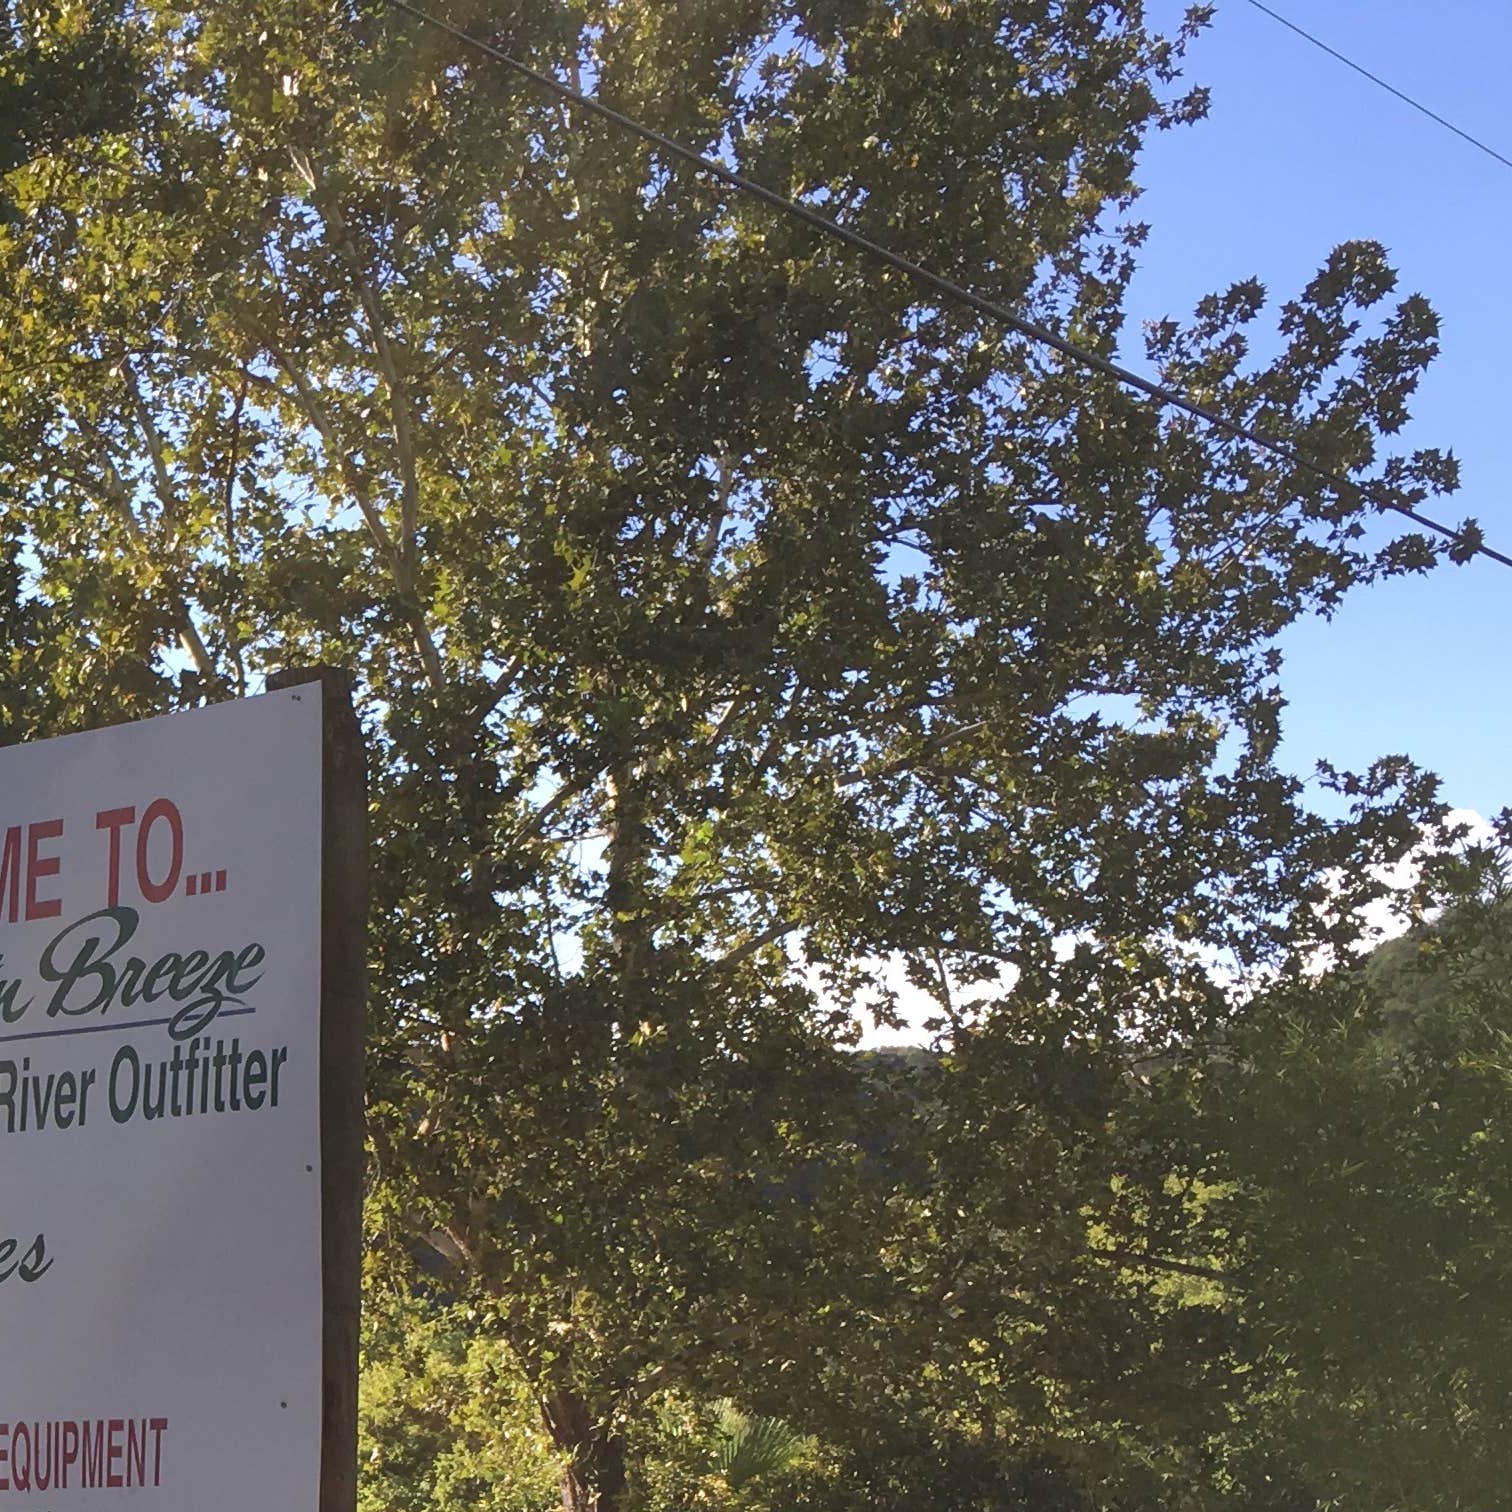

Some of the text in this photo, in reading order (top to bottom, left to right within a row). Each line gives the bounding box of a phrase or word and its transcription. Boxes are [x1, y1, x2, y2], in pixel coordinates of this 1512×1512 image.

[95, 798, 227, 908] TO...
[39, 906, 266, 1040] Breeze
[109, 1036, 287, 1124] Outfitter
